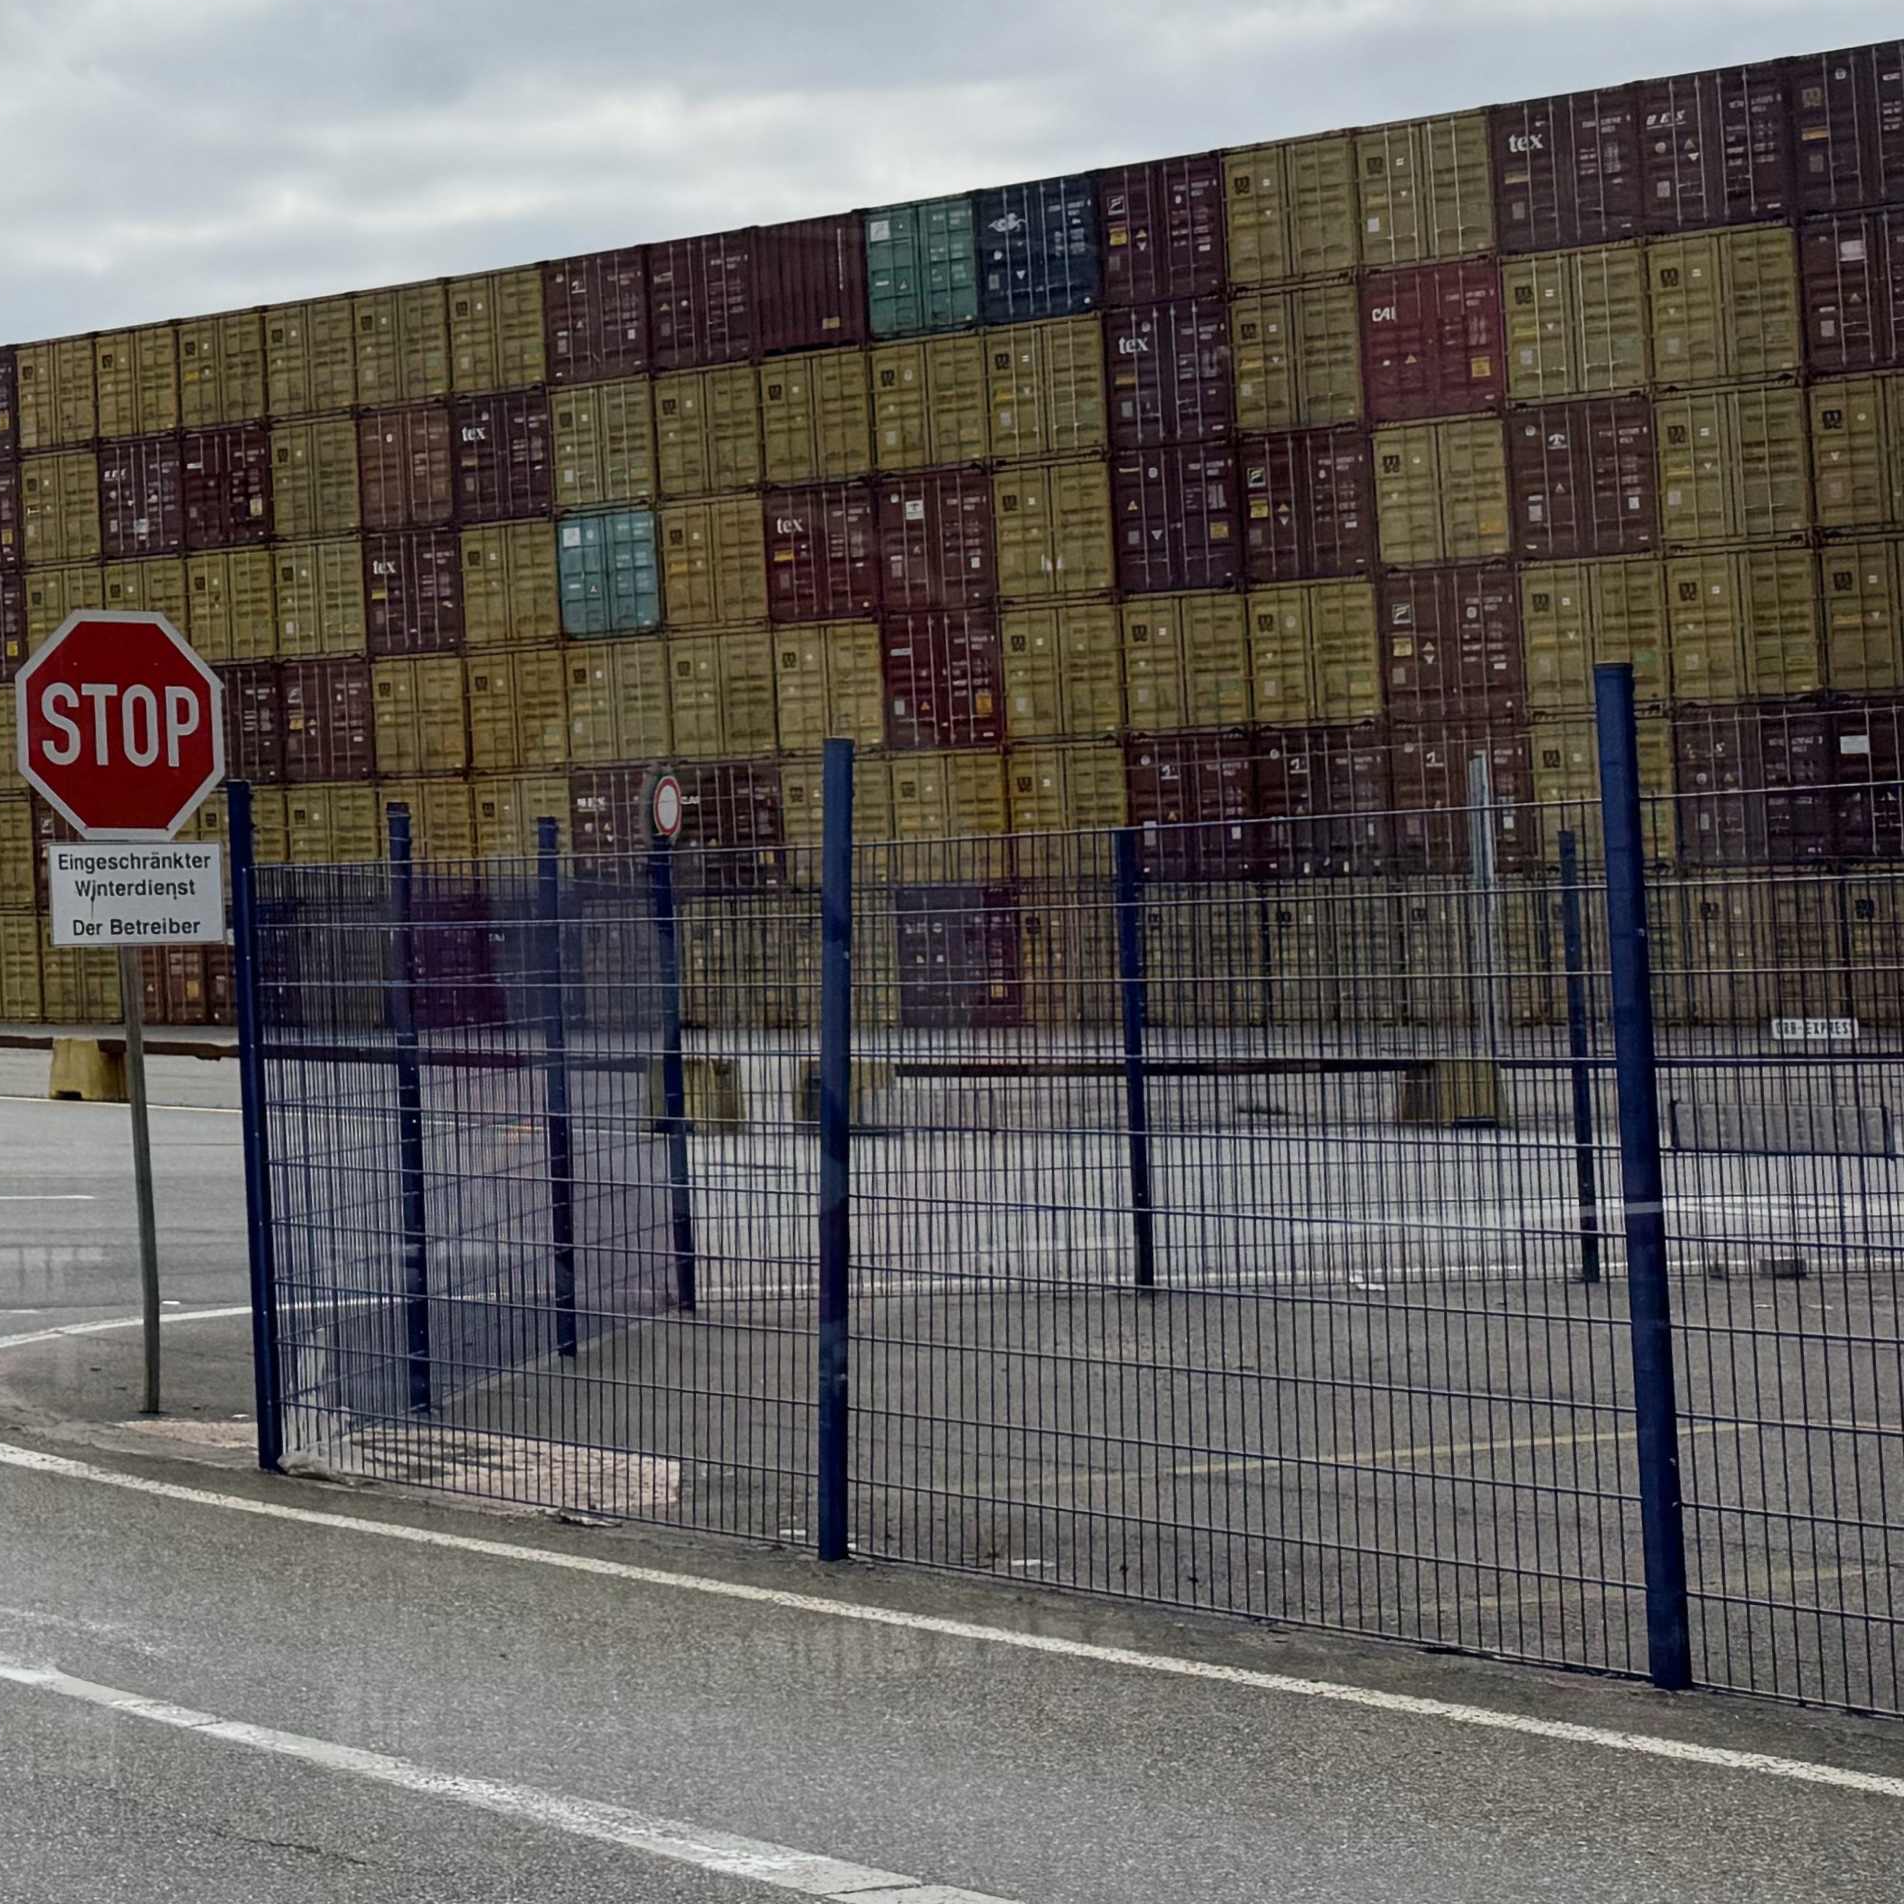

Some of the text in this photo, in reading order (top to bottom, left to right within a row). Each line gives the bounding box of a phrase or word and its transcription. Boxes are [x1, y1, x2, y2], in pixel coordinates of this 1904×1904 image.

[41, 682, 200, 767] STOP
[58, 851, 211, 874] Eingeschränkter
[75, 879, 196, 897] Winterdienst
[73, 918, 201, 936] Der Betreiber
